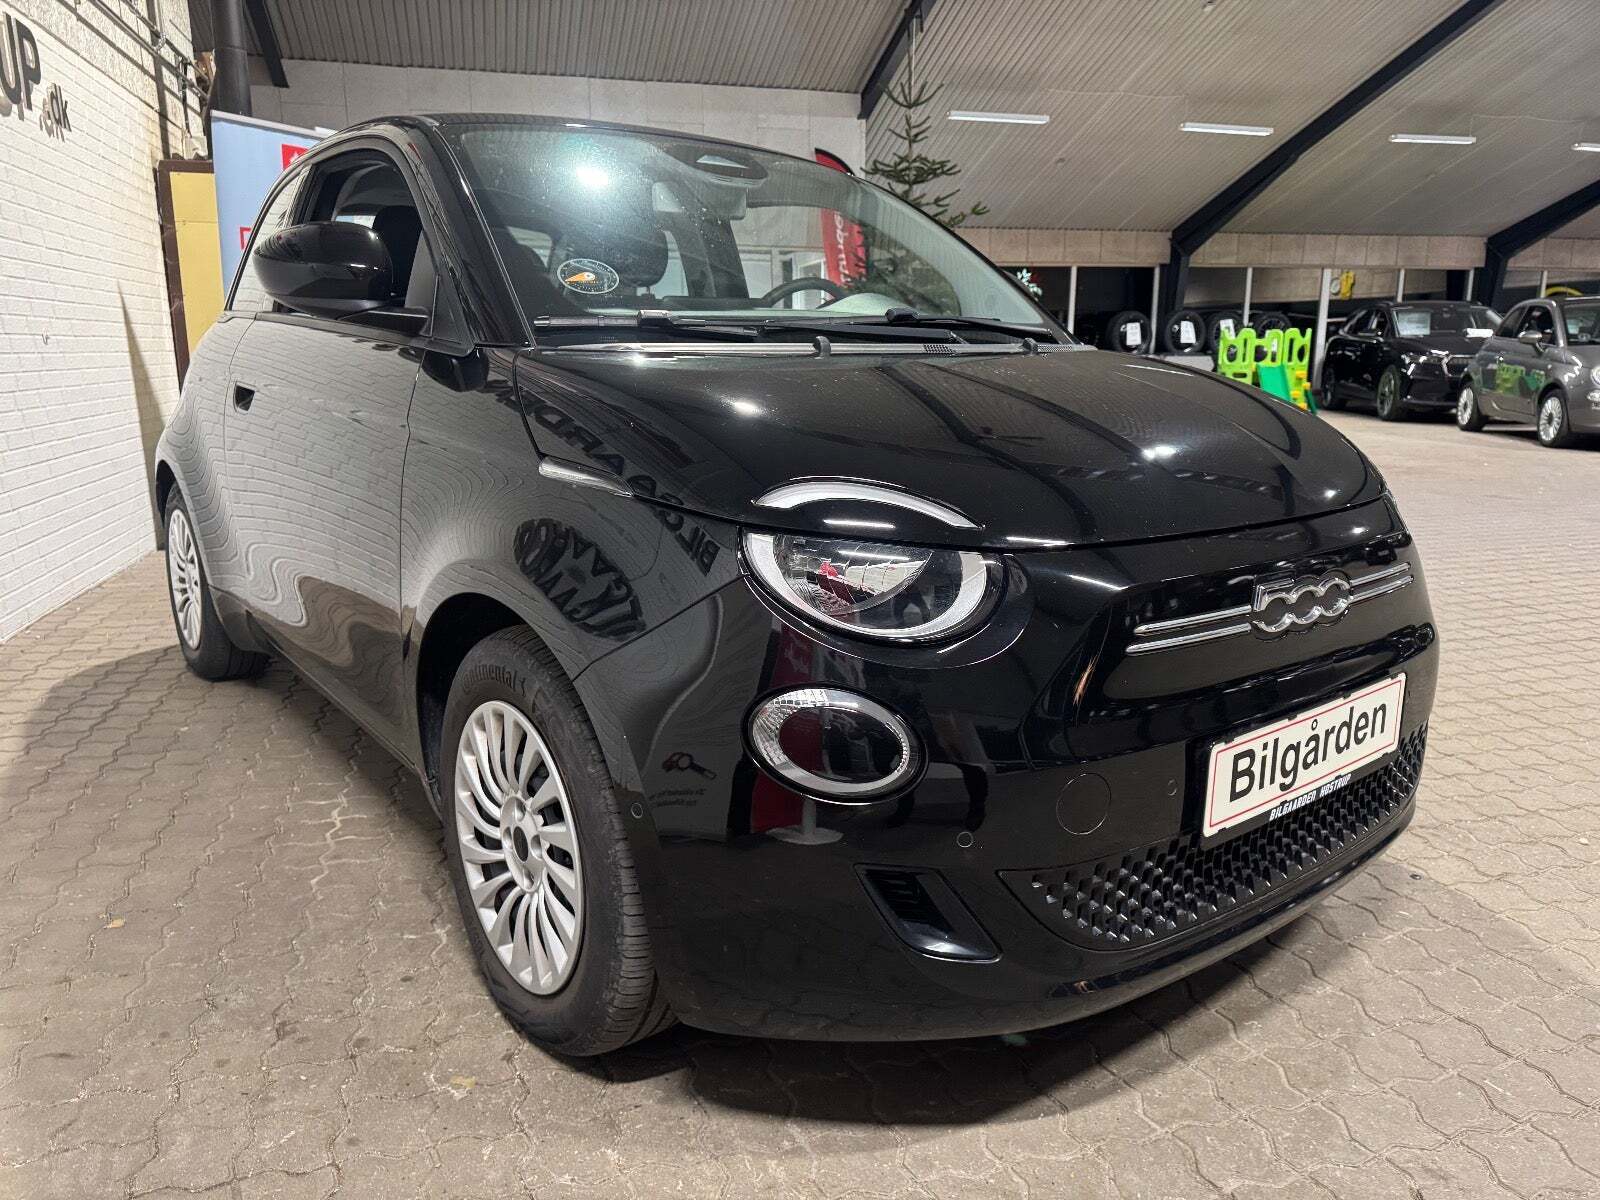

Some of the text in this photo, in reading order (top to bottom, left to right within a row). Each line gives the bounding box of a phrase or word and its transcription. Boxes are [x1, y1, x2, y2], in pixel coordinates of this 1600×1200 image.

[1252, 575, 1350, 634] 500
[1229, 702, 1387, 803] Bilgården
[1268, 790, 1317, 822] BILGAARDEN
